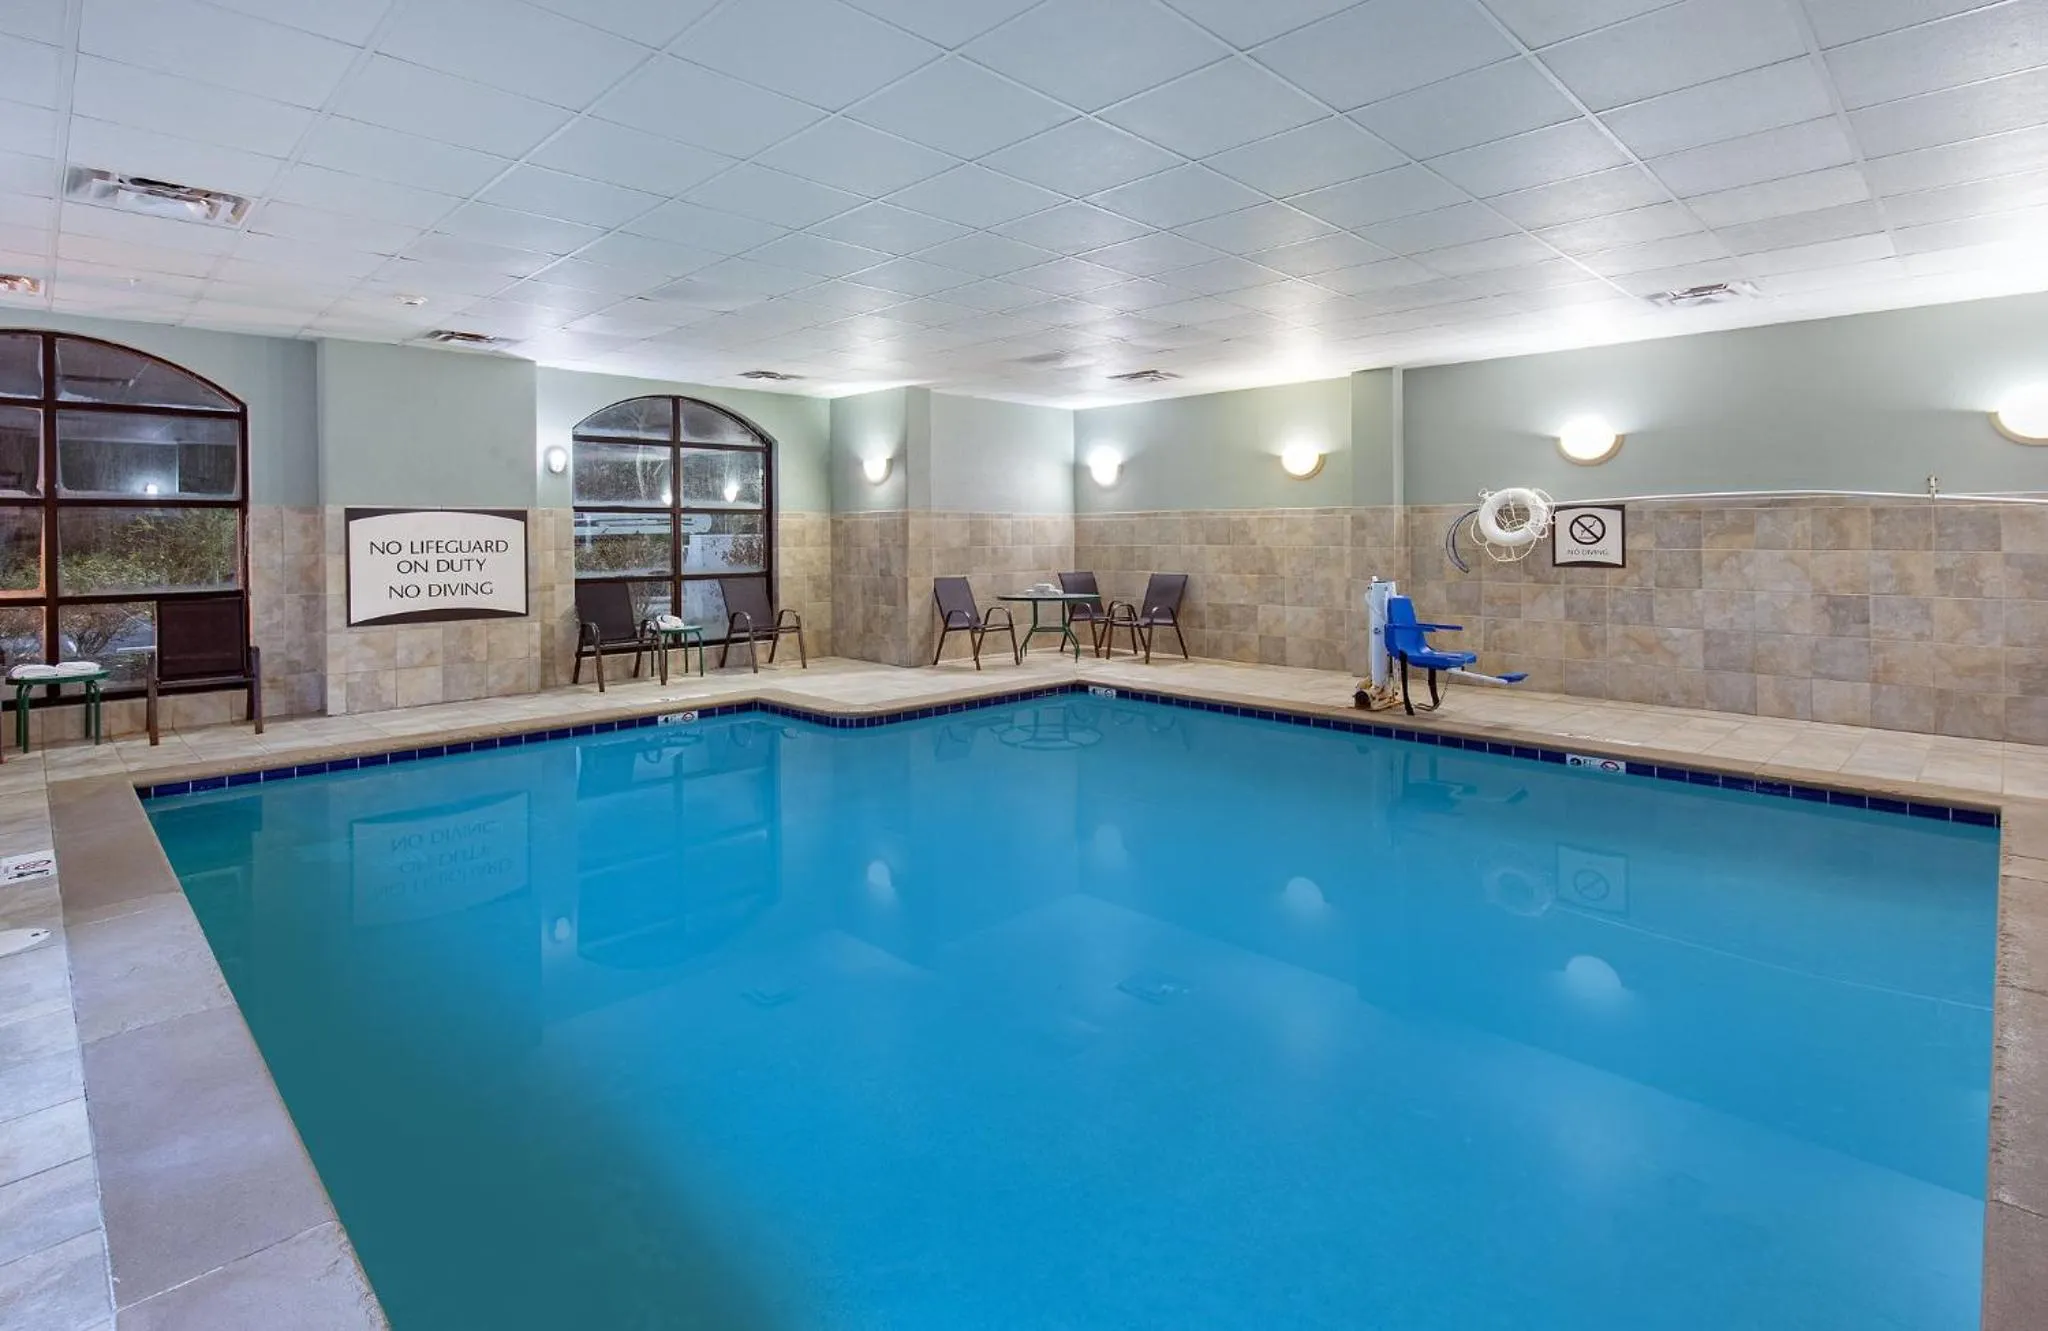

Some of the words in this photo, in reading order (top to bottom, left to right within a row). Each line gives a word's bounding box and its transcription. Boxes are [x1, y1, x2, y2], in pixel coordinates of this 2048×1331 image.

[369, 540, 402, 556] NO
[410, 539, 509, 554] LIFEGUARD
[1567, 548, 1580, 556] NO
[1581, 548, 1609, 556] DIVING
[396, 559, 429, 574] ON
[436, 558, 487, 573] DUTY
[388, 584, 421, 600] NO
[428, 581, 494, 598] DIVING
